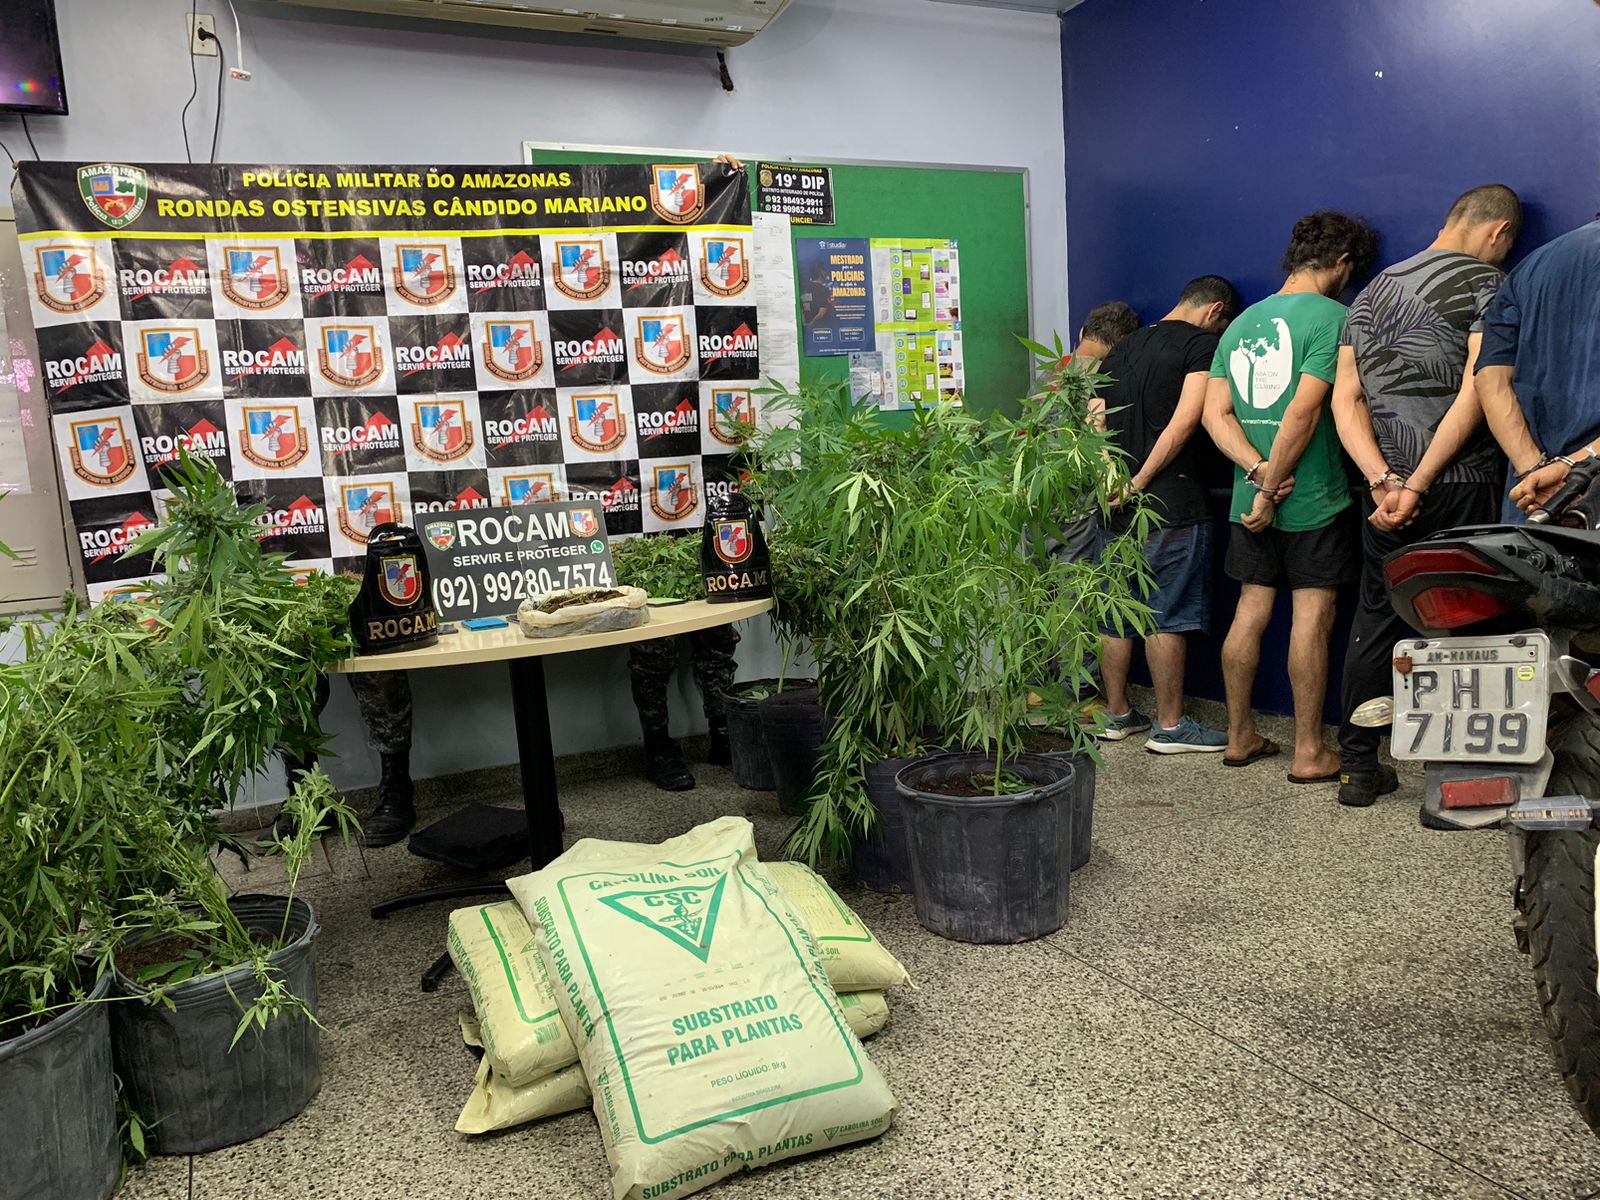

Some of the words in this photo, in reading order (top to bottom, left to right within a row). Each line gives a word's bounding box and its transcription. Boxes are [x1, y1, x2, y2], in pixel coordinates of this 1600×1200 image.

[81, 166, 143, 180] AMAZONAS
[242, 171, 330, 188] POLÍCIA
[337, 172, 424, 188] MILITAR
[428, 172, 456, 188] DO
[461, 172, 571, 188] AMAZONAS
[801, 175, 825, 190] DIP
[158, 199, 264, 218] RONDAS
[272, 198, 426, 218] OSTENSIVAS
[433, 195, 538, 217] CÂNDIDO
[544, 196, 646, 214] MARIANO
[772, 195, 781, 203] 92
[782, 197, 823, 206] 98493-9911
[772, 204, 781, 212] 92
[782, 205, 824, 215] 99962-4415
[790, 216, 812, 224] UNCIE!
[830, 255, 864, 264] MESTRADO
[302, 268, 380, 284] ROCAM
[468, 264, 540, 280] ROCAM
[622, 260, 688, 276] ROCAM
[832, 271, 864, 281] POLICIAIS
[120, 270, 207, 286] ROCAM
[503, 280, 541, 288] PROTEGER
[623, 276, 647, 286] SERVIR
[648, 276, 653, 284] E
[654, 275, 688, 284] PROTEGER
[122, 287, 153, 296] SERVIR
[155, 287, 160, 295] E
[163, 287, 207, 295] PROTEGER
[304, 285, 332, 294] SERVIR
[334, 285, 339, 293] E
[341, 284, 381, 293] PROTEGER
[554, 339, 624, 356] ROCAM
[700, 335, 758, 350] ROCAM
[223, 350, 303, 366] ROCAM
[396, 344, 470, 362] ROCAM
[556, 356, 581, 365] SERVIR
[583, 356, 587, 364] E
[589, 355, 624, 364] PROTEGER
[700, 351, 721, 359] SERVIR
[722, 350, 726, 359] E
[727, 350, 758, 358] PROTEGER
[45, 354, 122, 378] ROCAM
[225, 366, 254, 376] SERVIR
[256, 366, 261, 375] E
[263, 366, 305, 375] PROTEGER
[397, 363, 424, 371] SERVIR
[426, 362, 430, 370] E
[432, 361, 470, 370] PROTEGER
[50, 372, 77, 388] SERVIR
[84, 372, 122, 384] PROTEGER
[485, 417, 556, 436] ROCAM
[638, 411, 698, 427] ROCAM
[321, 424, 399, 442] ROCAM
[487, 436, 513, 444] SERVIR
[515, 435, 519, 443] E
[521, 434, 558, 443] PROTEGER
[639, 427, 668, 436] SERVIR
[668, 426, 672, 434] E
[141, 431, 225, 454] ROCAM
[323, 443, 351, 452] SERVIR
[353, 442, 358, 451] E
[360, 441, 400, 450] PROTEGER
[145, 453, 175, 463] SERVIR
[189, 449, 226, 458] OTEGER
[258, 508, 324, 526] OCAM
[282, 524, 325, 535] PROTEGER
[456, 512, 570, 548] ROCAM
[84, 546, 112, 558] SERVIR
[112, 546, 118, 554] E
[452, 552, 501, 567] SERVIR
[506, 552, 514, 562] E
[519, 544, 587, 560] PROTEGER
[432, 574, 478, 616] (92)
[486, 561, 612, 603] 99280-7574
[707, 570, 768, 592] ROCAM
[368, 610, 436, 640] ROCAM
[1412, 667, 1514, 708] PHI
[1407, 712, 1529, 754] 7199
[644, 892, 702, 907] CSC
[534, 896, 562, 951] SUBSTRATO
[553, 946, 570, 986] PARA
[672, 994, 778, 1036] SUBSTRATO
[667, 1034, 720, 1066] PARA
[722, 1013, 804, 1047] PLANTAS
[711, 1075, 734, 1088] PESO
[772, 1060, 786, 1070] 9kg
[604, 1082, 617, 1122] CAROLINA
[840, 1120, 870, 1133] CAROLINA
[871, 1117, 883, 1128] SOIL
[642, 1161, 720, 1200] SUBSTRATO
[758, 1132, 814, 1159] PLANTAS
